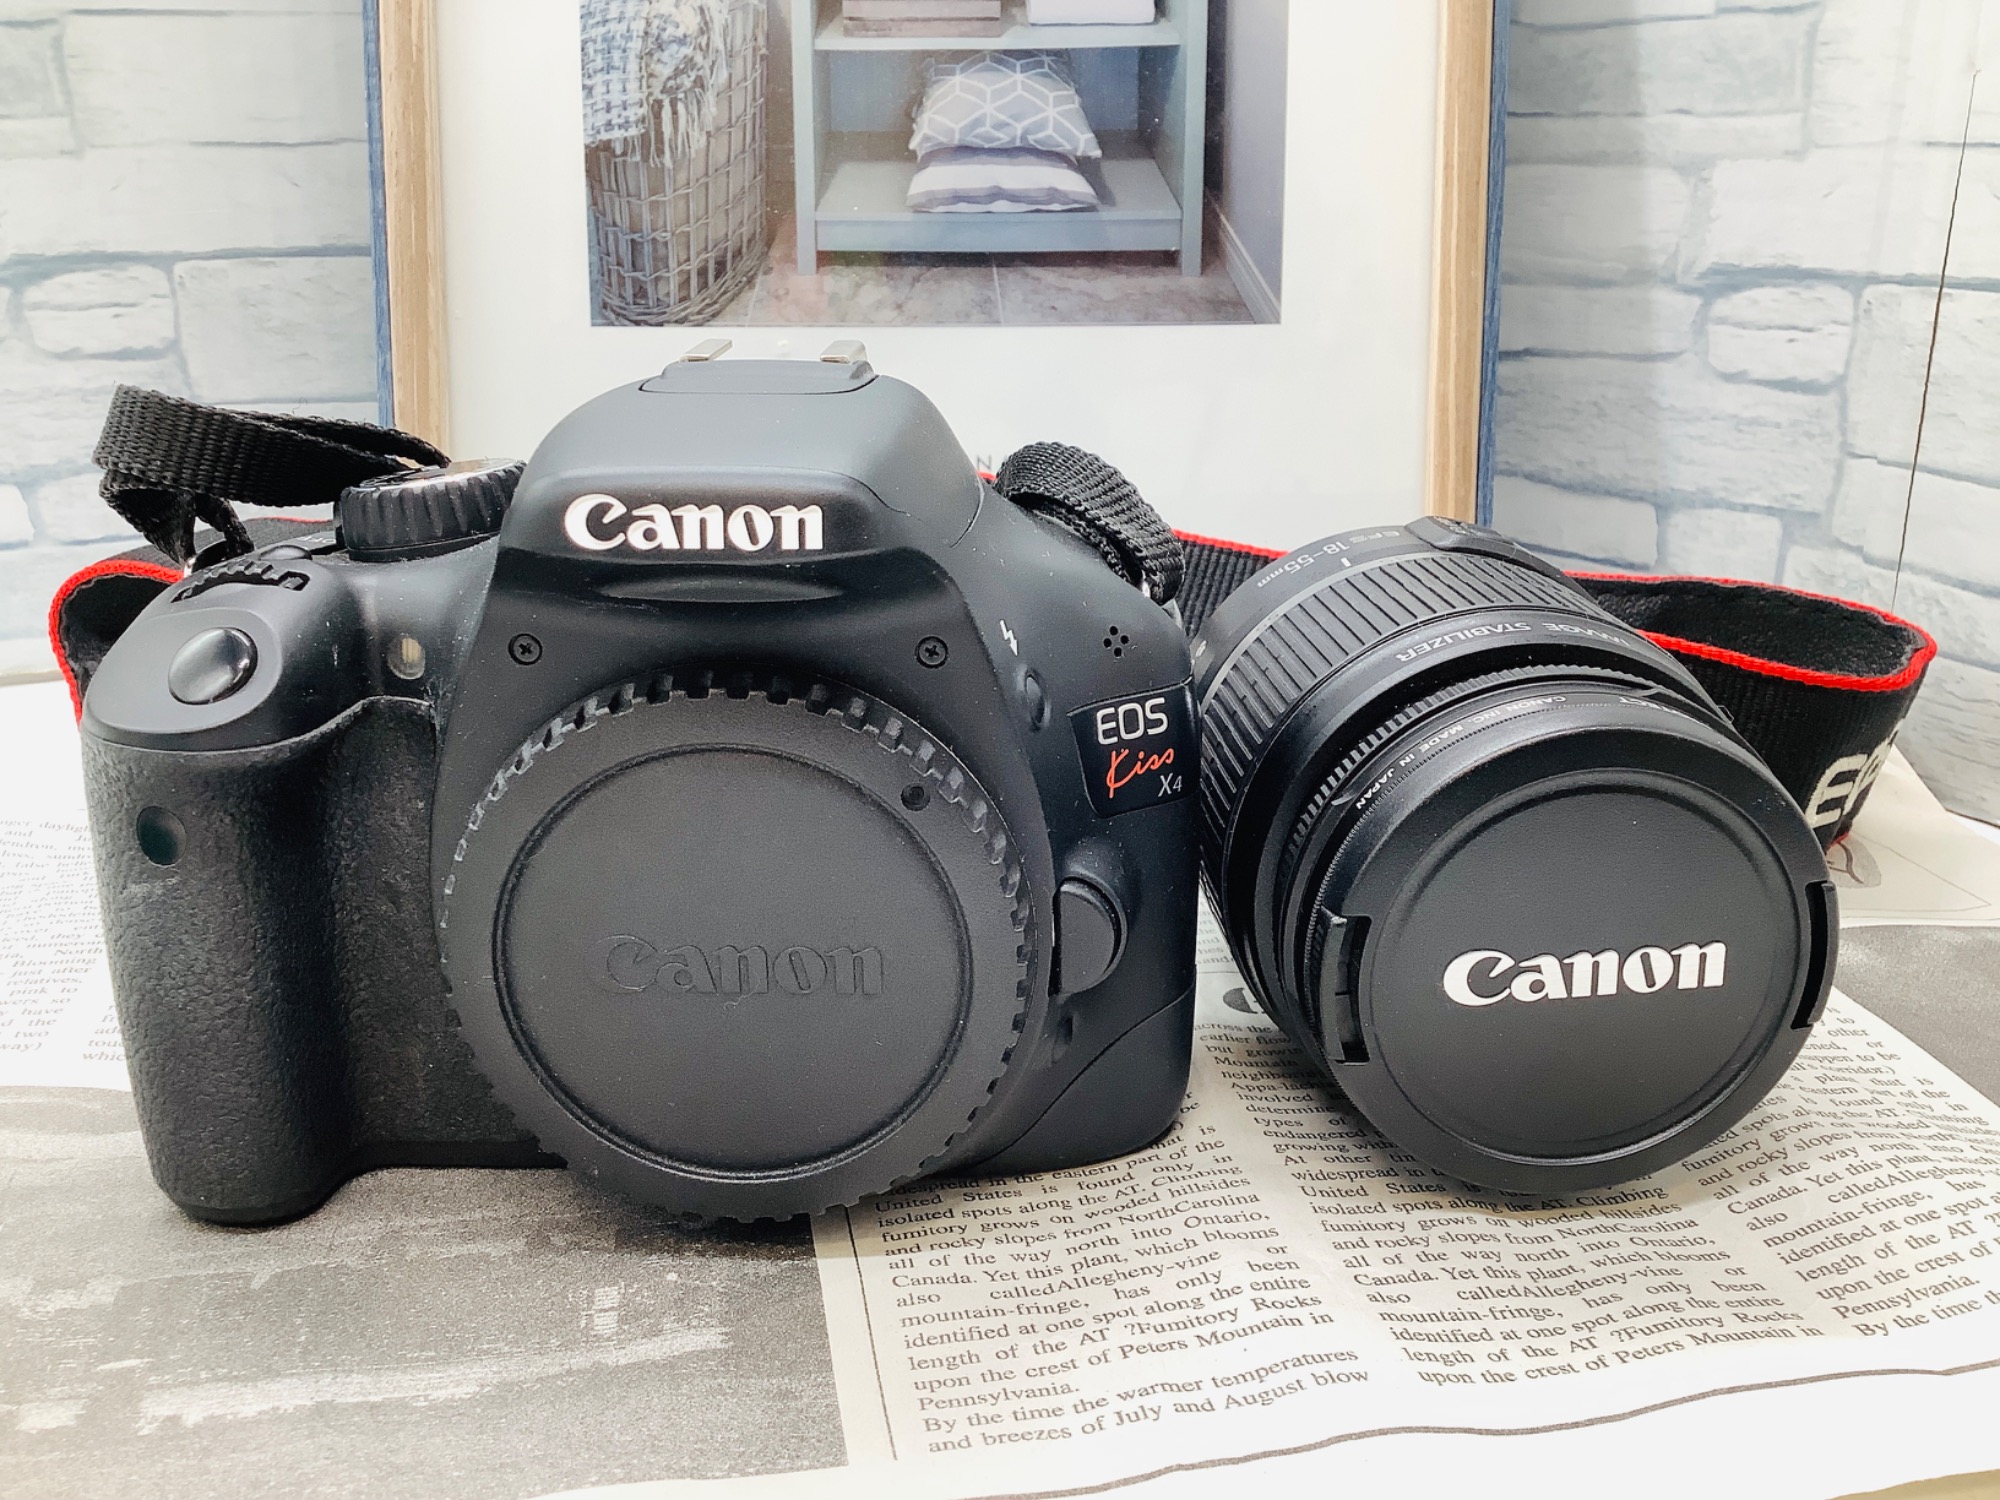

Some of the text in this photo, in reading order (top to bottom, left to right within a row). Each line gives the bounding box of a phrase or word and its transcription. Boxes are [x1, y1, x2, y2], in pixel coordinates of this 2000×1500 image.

[565, 493, 824, 551] Canon
[1256, 541, 1350, 588] 18-55mm
[1395, 621, 1631, 662] IMAGE STABILIZER
[1096, 697, 1168, 745] EOS
[1106, 748, 1174, 799] Kiss
[1355, 695, 1567, 810] CANON INC. MADE IN JAPAN
[1158, 773, 1183, 797] X4
[587, 934, 884, 996] Canon
[1443, 940, 1727, 1007] Canon
[878, 1165, 1243, 1228] isolated spots along the AT. Climbing
[881, 1176, 1251, 1243] fumitory grows on wooded hillsides
[1727, 1160, 1883, 1215] Canada. Yet this
[1763, 1177, 1987, 1248] mountain-fringe, has
[885, 1192, 1260, 1257] and rocky slopes from NorthCarolina
[889, 1209, 1270, 1270] all of the way north into Ontario,
[1745, 1211, 1789, 1232] also
[1776, 1194, 1990, 1266] identified at one spot
[1795, 1220, 1979, 1283] length of the AT
[892, 1225, 1280, 1288] Canada. Yet this plant, which blooms
[896, 1244, 1288, 1308] also calledAllegheny-vine or
[1354, 1249, 1731, 1287] Canada. Yet this plant, which blooms
[1366, 1266, 1748, 1304] also calledAllegheny-vine or
[1816, 1239, 1994, 1301] upon the crest of
[900, 1259, 1300, 1328] mountain-fringe, has only been
[904, 1276, 1311, 1350] identified at one spot along the entire
[1377, 1279, 1767, 1324] mountain-fringe, has only been
[1390, 1295, 1785, 1343] identified at one spot along the entire
[1831, 1273, 1980, 1320] Pennsylvania.
[1852, 1296, 1983, 1337] By the time
[908, 1294, 1323, 1371] length of the AT ?Fumitory Rocks
[913, 1311, 1335, 1394] upon the crest of Peters Mountain in
[1401, 1310, 1805, 1367] length of the AT ?Fumitory Rocks
[1417, 1324, 1826, 1387] upon the crest of Peters Mountain in
[917, 1382, 1080, 1412] Pennsylvania.
[922, 1349, 1359, 1434] By the time the warmer temperatures
[928, 1369, 1370, 1453] and breezes of July and August blow
